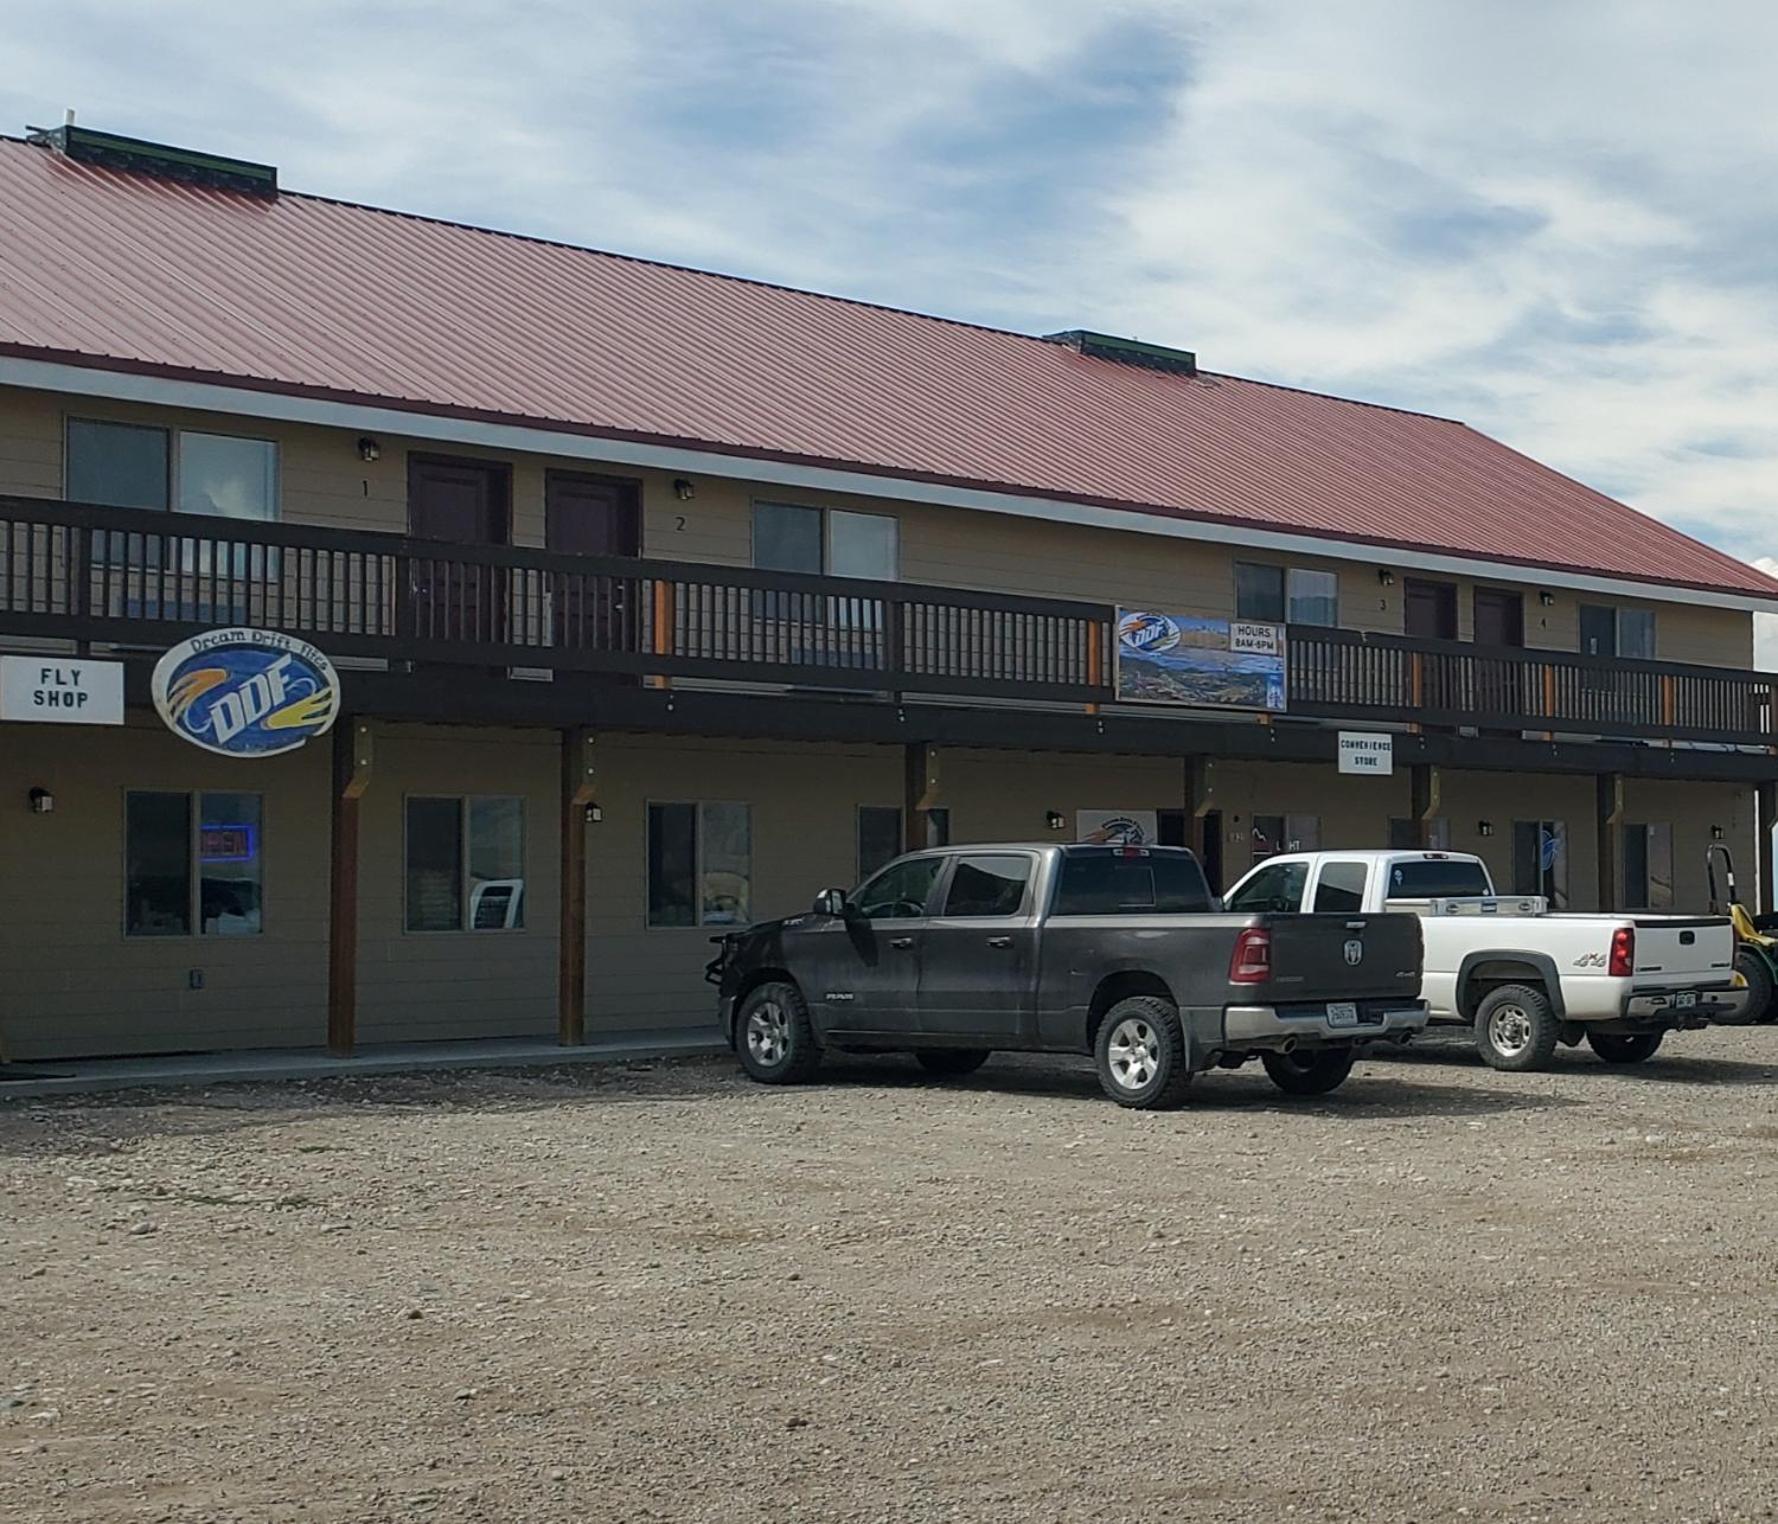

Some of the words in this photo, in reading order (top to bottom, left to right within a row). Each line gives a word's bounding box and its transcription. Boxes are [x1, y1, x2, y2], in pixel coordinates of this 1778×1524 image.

[362, 479, 369, 498] 1
[675, 516, 686, 532] 2
[1379, 599, 1387, 611] 3
[1539, 617, 1547, 628] 4
[1238, 625, 1271, 638] HOURS
[190, 631, 247, 653] Dream
[251, 630, 292, 650] Drift
[40, 667, 82, 687] FLY
[33, 689, 89, 709] SHOP
[209, 652, 293, 745] DDF
[1354, 756, 1378, 767] STORE
